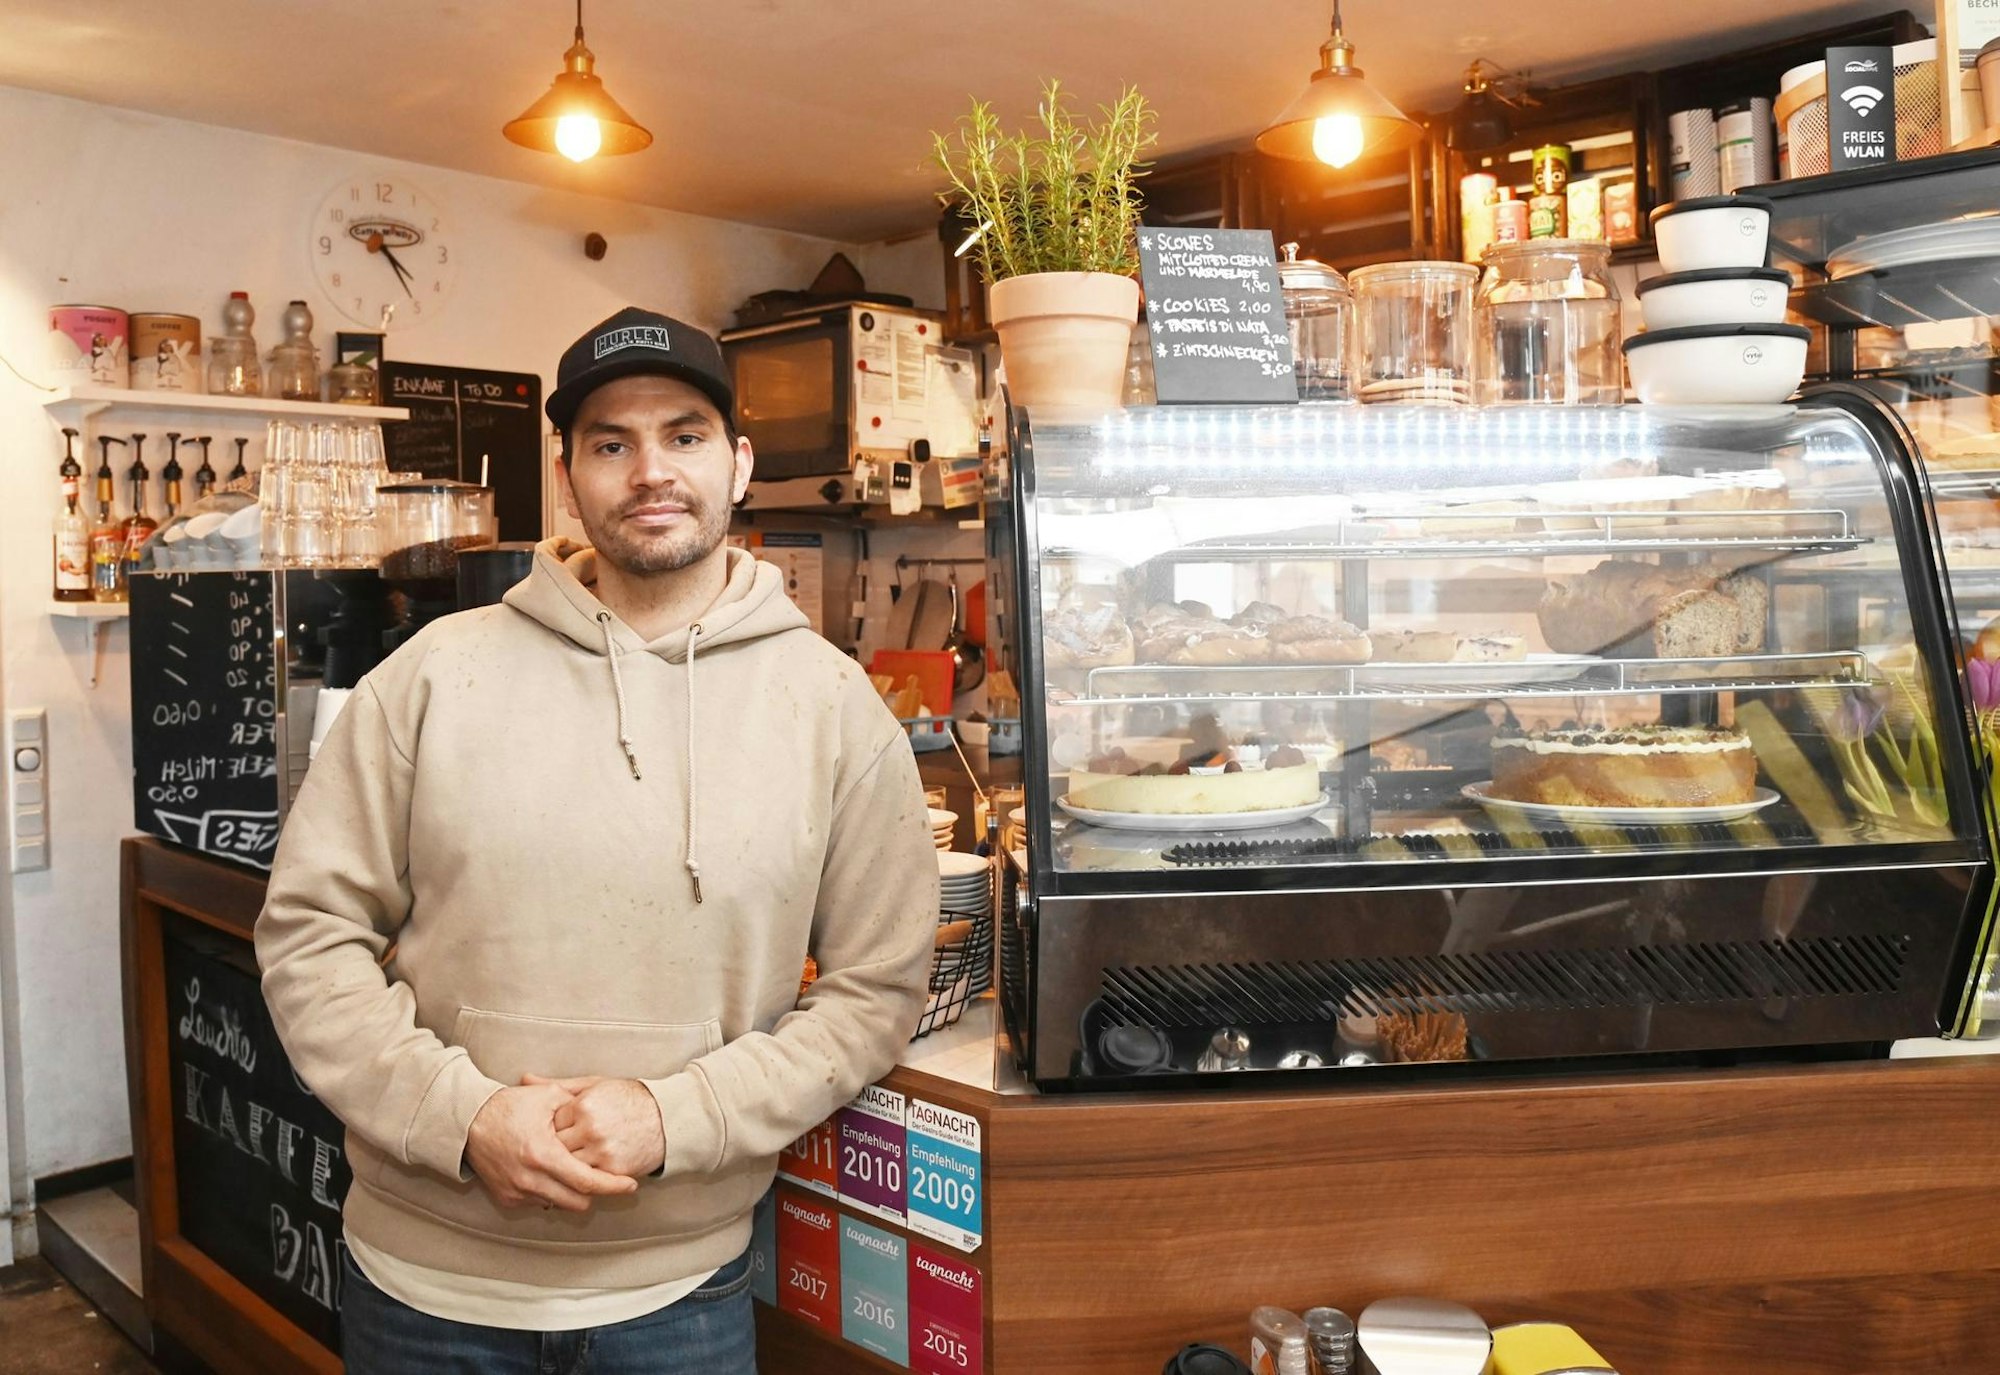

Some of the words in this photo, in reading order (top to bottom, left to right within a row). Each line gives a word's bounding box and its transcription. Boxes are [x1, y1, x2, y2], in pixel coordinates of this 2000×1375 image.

[1843, 130, 1885, 144] FREIES
[1843, 145, 1885, 158] WLAN
[351, 188, 360, 202] 11
[376, 183, 393, 203] 12
[330, 208, 344, 222] 10
[431, 218, 440, 232] 2
[319, 236, 331, 255] 9
[1157, 233, 1214, 251] SCONES
[437, 246, 448, 264] 3
[1230, 254, 1272, 267] CREAM
[1242, 279, 1270, 294] 4,90
[1239, 300, 1271, 315] 2,00
[1236, 320, 1270, 334] NATA
[599, 329, 664, 351] HURLEY
[1261, 334, 1289, 348] 3,20
[1261, 363, 1291, 378] 3,50
[859, 1086, 902, 1112] NACHT
[911, 1103, 976, 1138] TAGNACHT
[781, 1133, 832, 1169] 011
[842, 1124, 901, 1159] Empfehlung
[843, 1145, 900, 1192] 2010
[911, 1144, 975, 1181] Empfehlung
[912, 1166, 975, 1216] 2009
[782, 1200, 832, 1230] tagnacht
[846, 1226, 900, 1257] tagnacht
[916, 1255, 975, 1289] tagnacht
[790, 1267, 827, 1301] 2017
[853, 1296, 895, 1330] 2016
[923, 1328, 968, 1367] 2015
